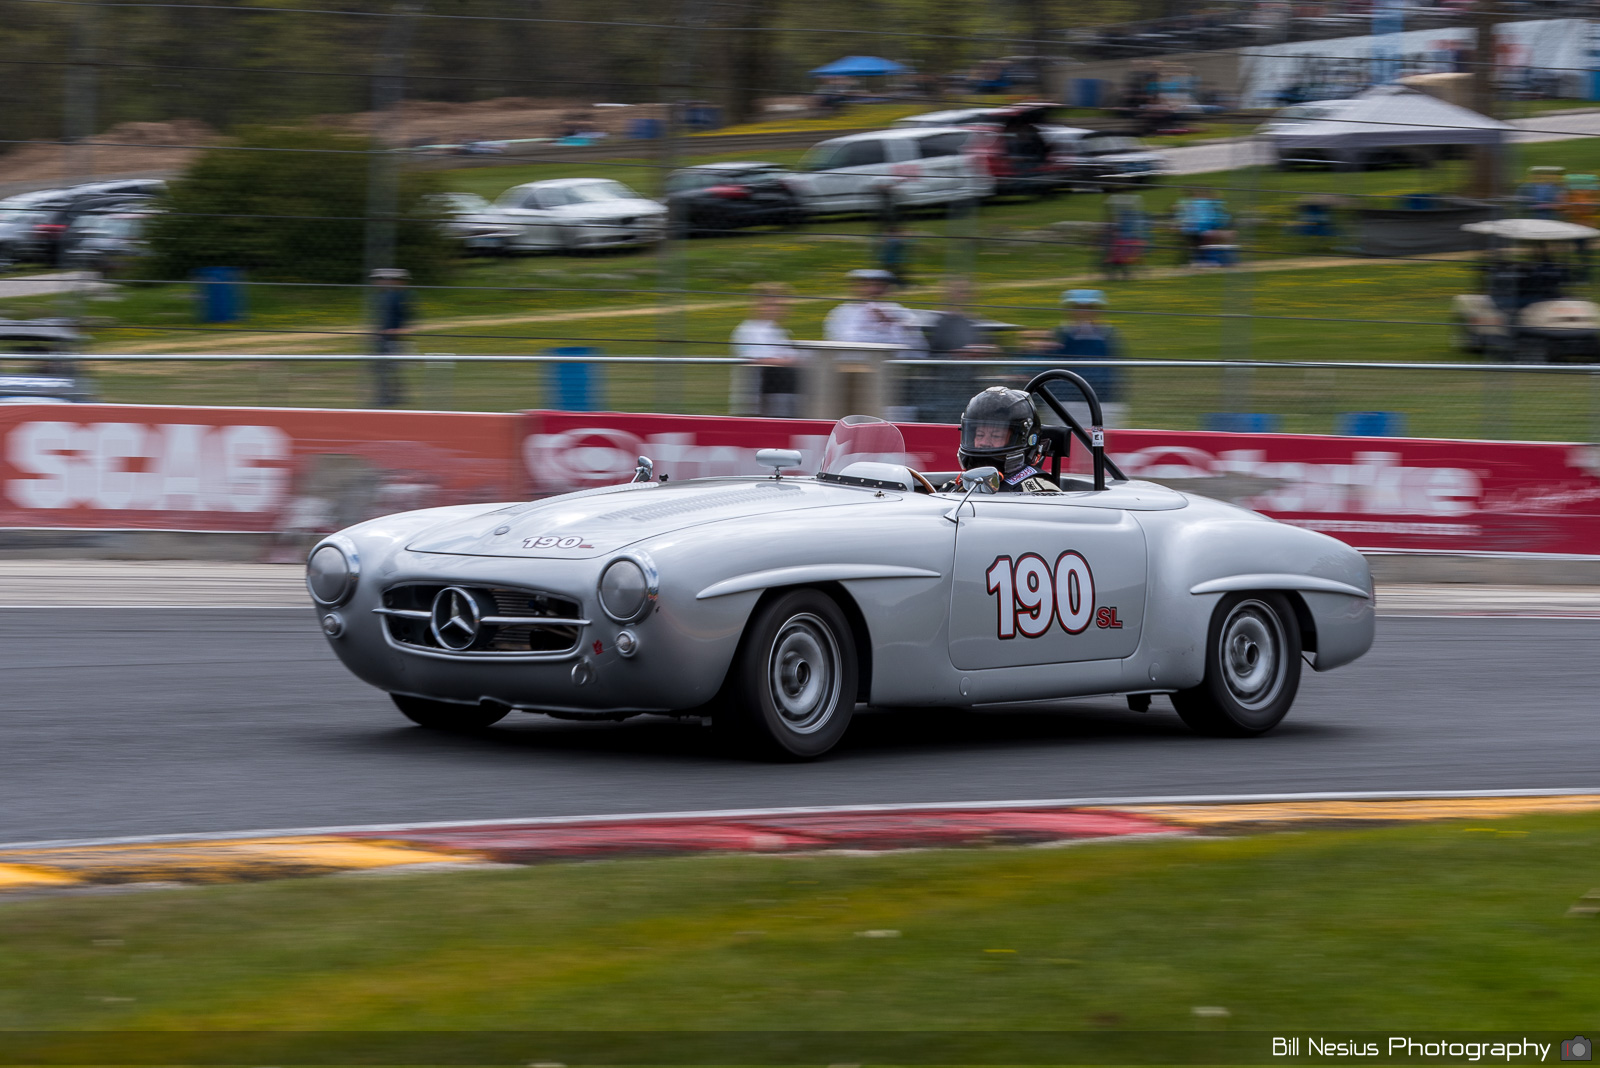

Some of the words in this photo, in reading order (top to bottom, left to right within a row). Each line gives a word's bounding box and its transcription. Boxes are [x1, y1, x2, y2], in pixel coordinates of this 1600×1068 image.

[5, 421, 290, 512] SCAG
[522, 536, 583, 549] 190
[986, 549, 1095, 640] 190
[1096, 606, 1123, 629] SL
